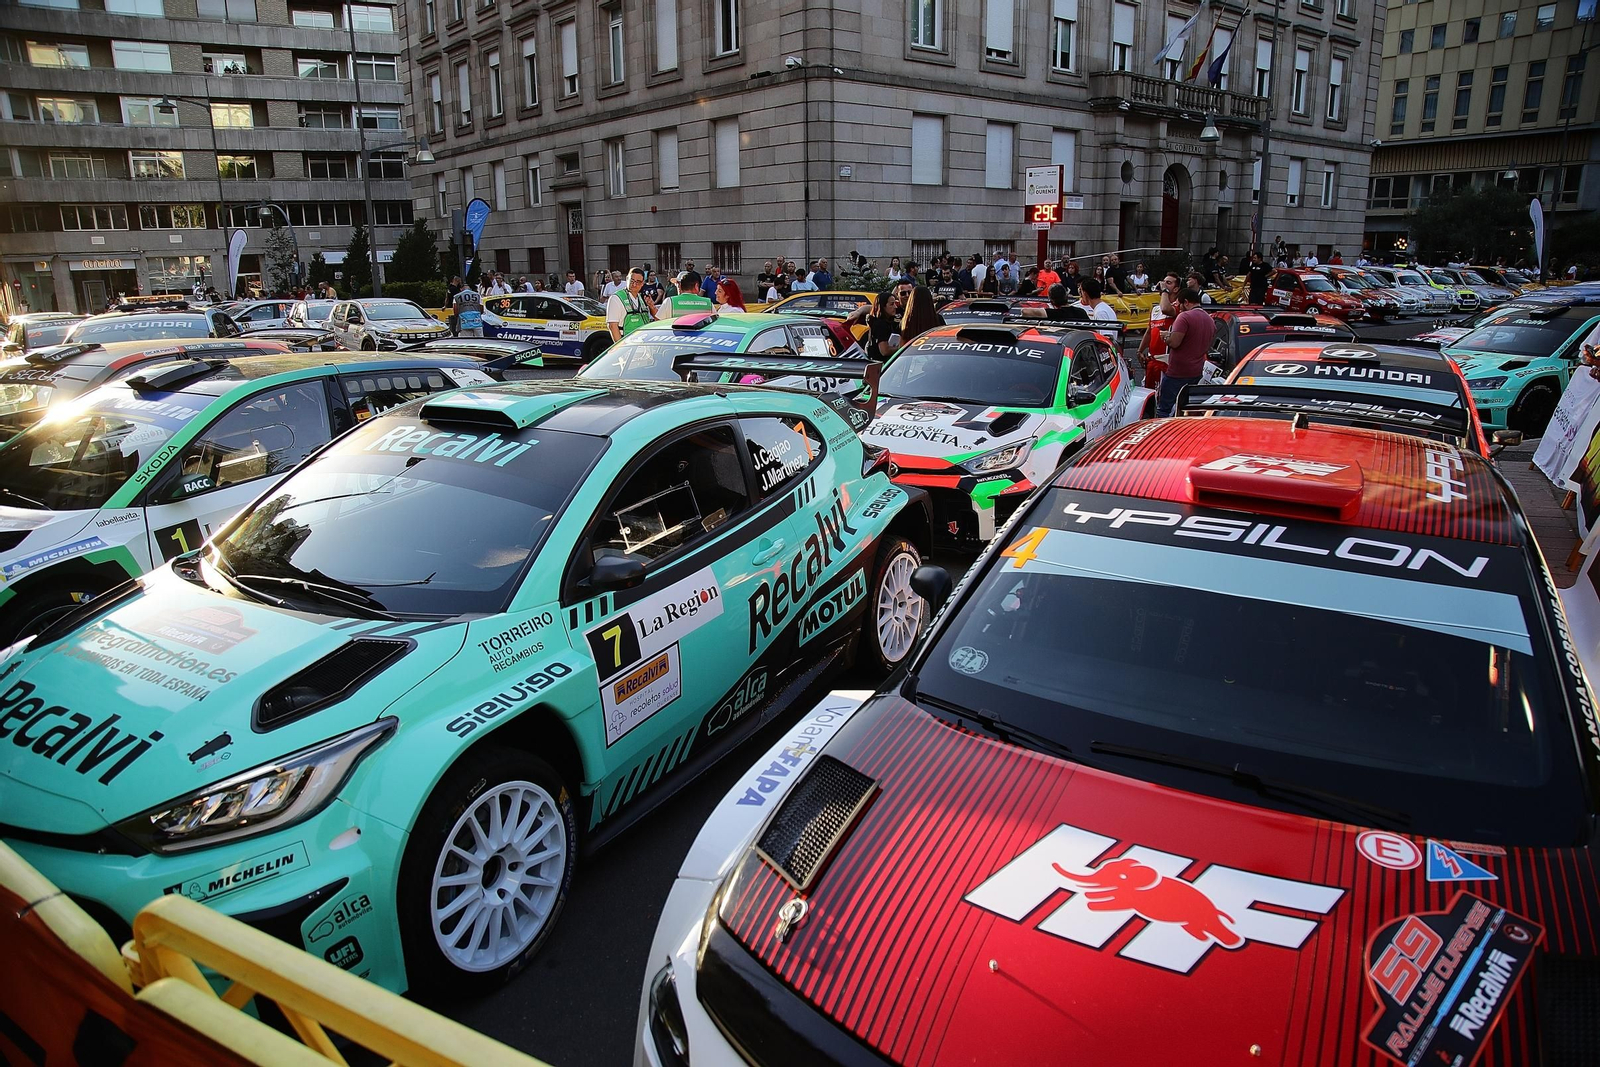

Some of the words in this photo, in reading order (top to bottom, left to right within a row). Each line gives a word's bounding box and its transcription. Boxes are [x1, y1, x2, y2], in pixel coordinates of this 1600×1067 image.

[114, 322, 192, 330] HYUNDAI
[497, 330, 533, 342] SÁNDEZ
[649, 335, 739, 347] MICHELIN
[1239, 325, 1251, 334] 5
[917, 342, 1045, 359] CARMOTIVE
[1314, 365, 1432, 385] HYUNDAI
[1310, 398, 1442, 421] YPSILON
[364, 424, 541, 467] Recalvi
[753, 439, 791, 471] J.Cagiao
[793, 421, 814, 461] 7
[183, 478, 211, 493] RACC
[29, 540, 102, 568] MICHELIN
[170, 527, 190, 553] 1
[1001, 527, 1050, 569] 4
[1064, 502, 1489, 579] YPSILON
[748, 487, 857, 657] Recalvi
[602, 624, 622, 668] 7
[638, 614, 665, 640] La
[667, 583, 719, 626] Región
[799, 575, 865, 642] MOTUL
[478, 611, 554, 655] TORREIRO
[489, 646, 514, 665] AUTO
[493, 641, 545, 674] RECAMBIOS
[119, 662, 139, 676] EN
[134, 667, 168, 687] TODA
[162, 677, 211, 702] ESPAÑA
[626, 661, 659, 695] Recalvi
[733, 670, 768, 710] alca
[630, 692, 661, 718] recoletos
[662, 677, 679, 696] salud
[208, 853, 294, 893] MICHELIN
[334, 894, 371, 924] alca
[963, 822, 1350, 976] HF
[330, 942, 356, 963] UFI
[1369, 915, 1444, 1006] 59
[1385, 969, 1446, 1058] RALLYE
[1437, 900, 1492, 981] OURENSE
[1459, 960, 1512, 1032] Recalvi
